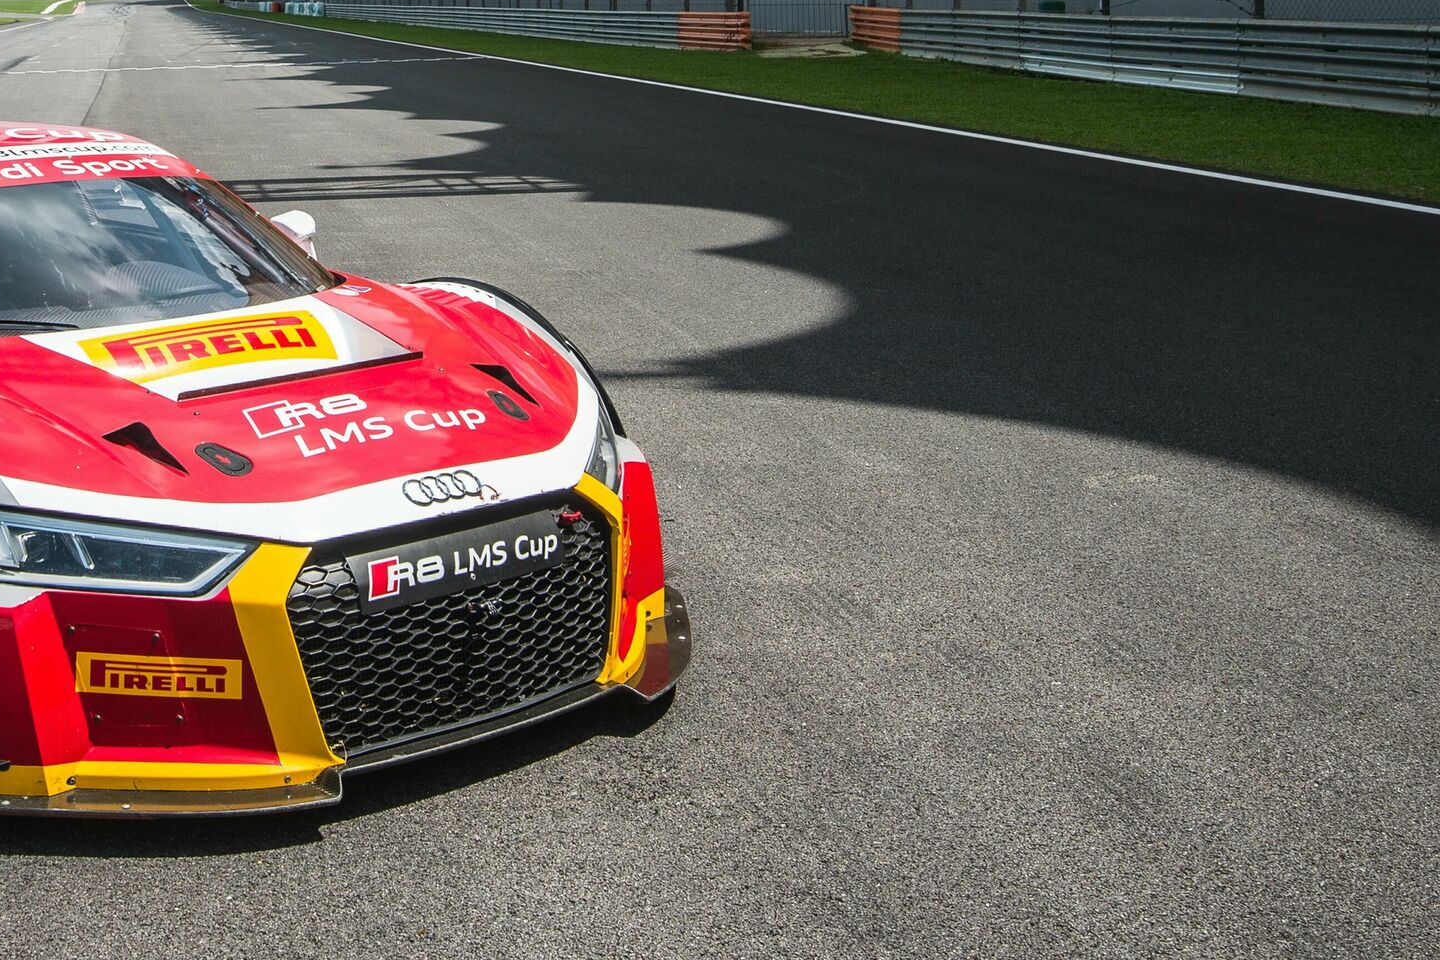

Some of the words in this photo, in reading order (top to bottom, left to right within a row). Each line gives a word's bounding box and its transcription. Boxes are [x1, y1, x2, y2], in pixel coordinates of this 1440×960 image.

[4, 127, 125, 142] Cup
[52, 156, 170, 177] Sport
[103, 315, 317, 369] PIRELLI
[276, 394, 367, 428] R8
[295, 418, 393, 458] LMS
[410, 406, 487, 432] Cup
[387, 554, 444, 591] R8
[453, 541, 508, 575] LMS
[514, 532, 559, 564] Cup
[90, 659, 228, 694] PIRELLI
